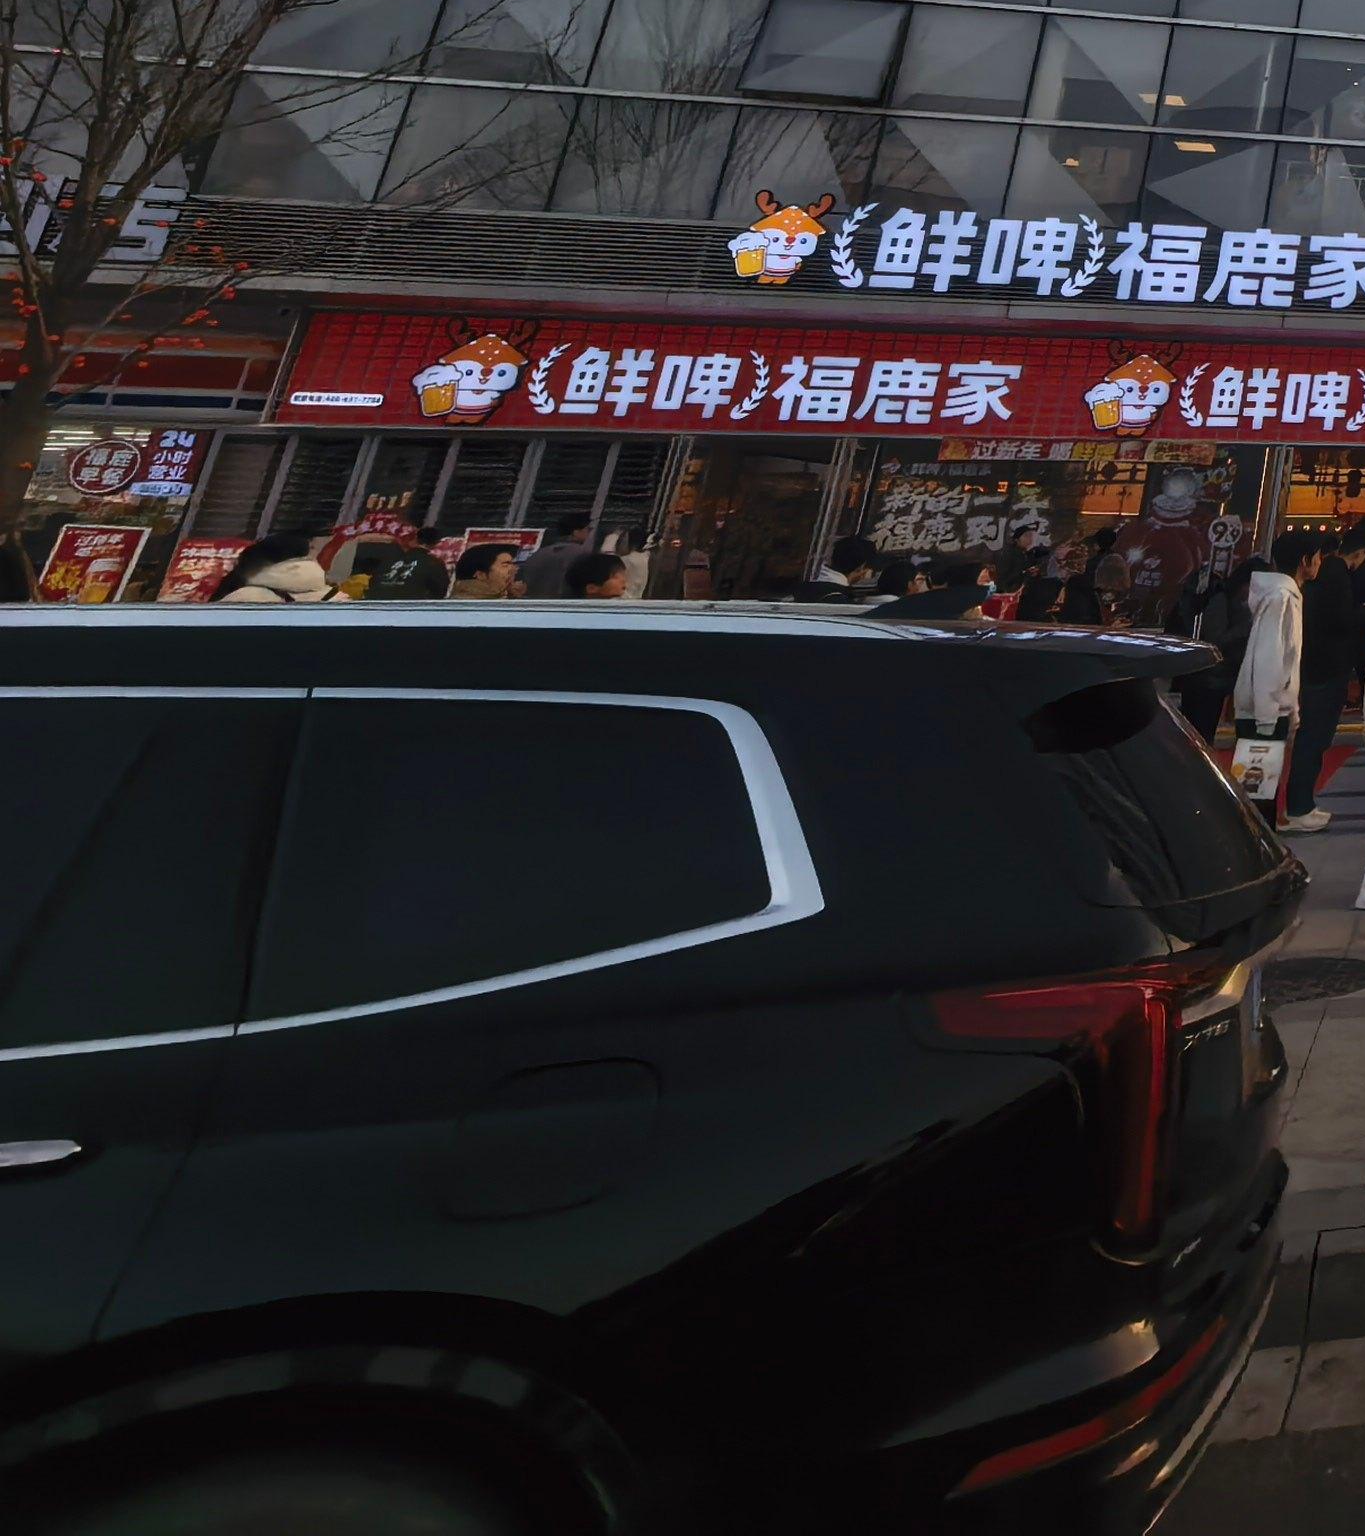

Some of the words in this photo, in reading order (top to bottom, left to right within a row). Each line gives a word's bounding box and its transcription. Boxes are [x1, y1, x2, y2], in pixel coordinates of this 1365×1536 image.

[868, 208, 1077, 297] 鲜啤
[559, 346, 741, 419] 鲜啤
[773, 355, 1023, 425] 福鹿家
[1205, 366, 1351, 432] 鲜啤
